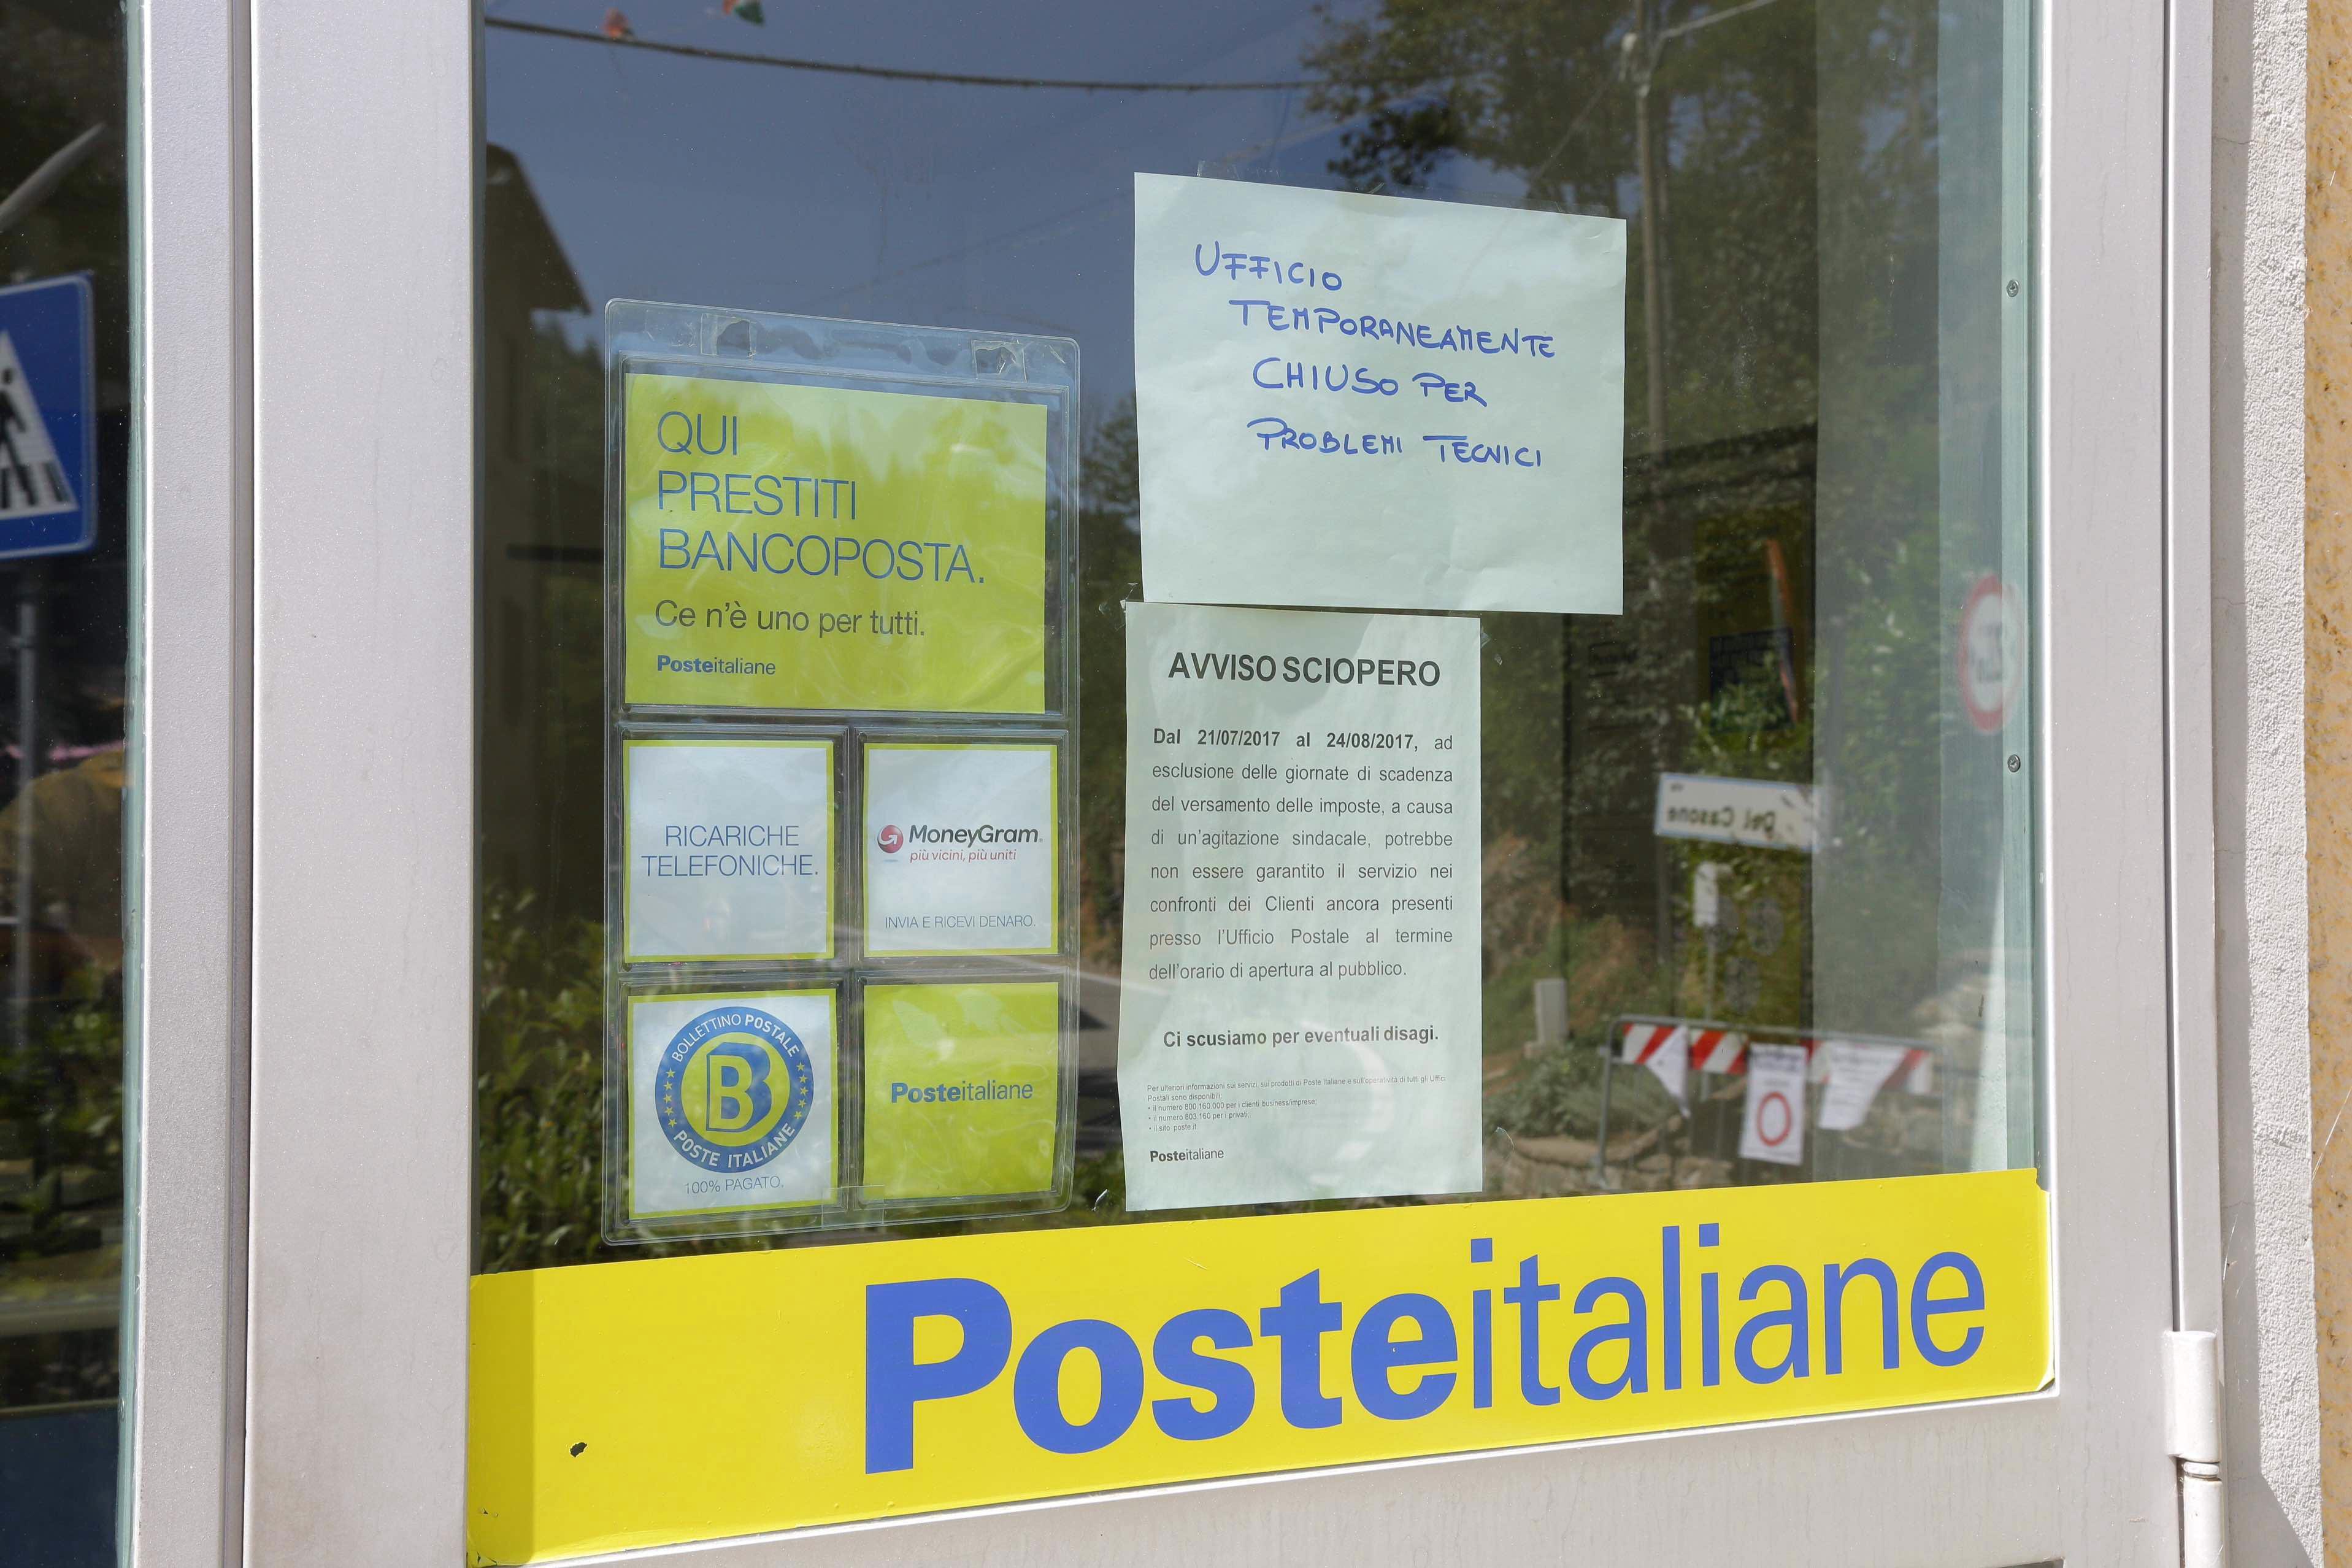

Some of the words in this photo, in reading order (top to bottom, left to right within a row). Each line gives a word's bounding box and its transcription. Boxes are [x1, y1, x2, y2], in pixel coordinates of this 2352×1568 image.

[1195, 241, 1342, 291] UFFICIO
[1229, 299, 1556, 358] TEMPORANEAMENTE
[1253, 356, 1399, 396] CHIUSO
[1413, 372, 1487, 407] PER
[657, 411, 737, 456] QUI
[1247, 417, 1402, 455] PROBLEMI
[1423, 436, 1542, 467] TECNICI
[658, 470, 856, 520] PRESTITI
[659, 528, 985, 583] BANCOPOSTA.
[655, 600, 696, 627] Ce
[706, 602, 747, 629] n'è
[757, 610, 809, 631] uno
[820, 611, 863, 638] per
[870, 610, 926, 636] tutti.
[657, 655, 776, 675] Posteitaliane
[1168, 652, 1277, 682] AVVISO
[1282, 656, 1440, 686] SCIOPERO
[1153, 728, 1181, 745] Dal
[1197, 729, 1280, 746] 21/07/2017
[1296, 732, 1310, 748] al
[1326, 732, 1418, 751] 24/08/2017,
[1434, 736, 1453, 750] ad
[1152, 763, 1234, 780] esclusione
[1242, 764, 1277, 780] delle
[1285, 766, 1349, 783] giornate
[1357, 766, 1371, 781] di
[1379, 766, 1453, 782] scadenza
[1152, 796, 1175, 812] del
[1181, 797, 1270, 813] versamento
[1276, 797, 1313, 813] delle
[1320, 798, 1385, 817] imposte,
[1391, 802, 1401, 814] a
[1407, 802, 1453, 815] causa
[664, 825, 800, 847] RICARICHE
[909, 824, 1039, 848] MoneyGram
[1151, 829, 1164, 845] di
[1178, 829, 1280, 849] un'agitazione
[1292, 831, 1371, 848] sindacale,
[1385, 831, 1453, 850] potrebbe
[642, 854, 818, 877] TELEFONICHE.
[910, 850, 929, 863] più
[932, 850, 966, 862] vicini,
[969, 849, 987, 863] più
[991, 849, 1017, 860] uniti
[1151, 865, 1178, 878] non
[1192, 865, 1243, 878] essere
[1256, 863, 1325, 883] garantito
[1337, 863, 1345, 878] il
[1358, 864, 1417, 878] servizio
[1430, 864, 1453, 878] nei
[1150, 896, 1216, 912] confronti
[1228, 896, 1251, 912] dei
[1265, 895, 1315, 912] Clienti
[1326, 897, 1380, 912] ancora
[1391, 895, 1453, 914] presenti
[885, 917, 918, 928] INVIA
[923, 917, 931, 928] E
[935, 916, 975, 928] RICEVI
[980, 915, 1036, 927] DENARO.
[1150, 931, 1201, 950] presso
[1218, 928, 1274, 945] l'Ufficio
[1291, 928, 1350, 944] Postale
[1366, 928, 1379, 943] al
[1395, 928, 1453, 943] termine
[1149, 963, 1224, 980] dell'orario
[1230, 962, 1243, 979] di
[1248, 964, 1314, 980] apertura
[1320, 961, 1332, 977] al
[1339, 961, 1407, 979] pubblico.
[672, 1014, 741, 1063] BOLLETTINO
[745, 1014, 799, 1057] POSTALE
[1164, 1031, 1180, 1047] Ci
[1186, 1031, 1267, 1047] scusiamo
[1272, 1029, 1299, 1048] per
[1304, 1026, 1380, 1043] eventuali
[1384, 1025, 1439, 1044] disagi.
[706, 1042, 772, 1132] B
[891, 1080, 1034, 1103] Posteitaliane
[674, 1129, 720, 1167] POSTE
[728, 1123, 795, 1168] ITALIANE
[1150, 1148, 1224, 1162] Posteitaliane
[685, 1180, 721, 1194] 100%
[725, 1176, 784, 1191] PAGATO.
[866, 1222, 1985, 1474] Posteitaliane
